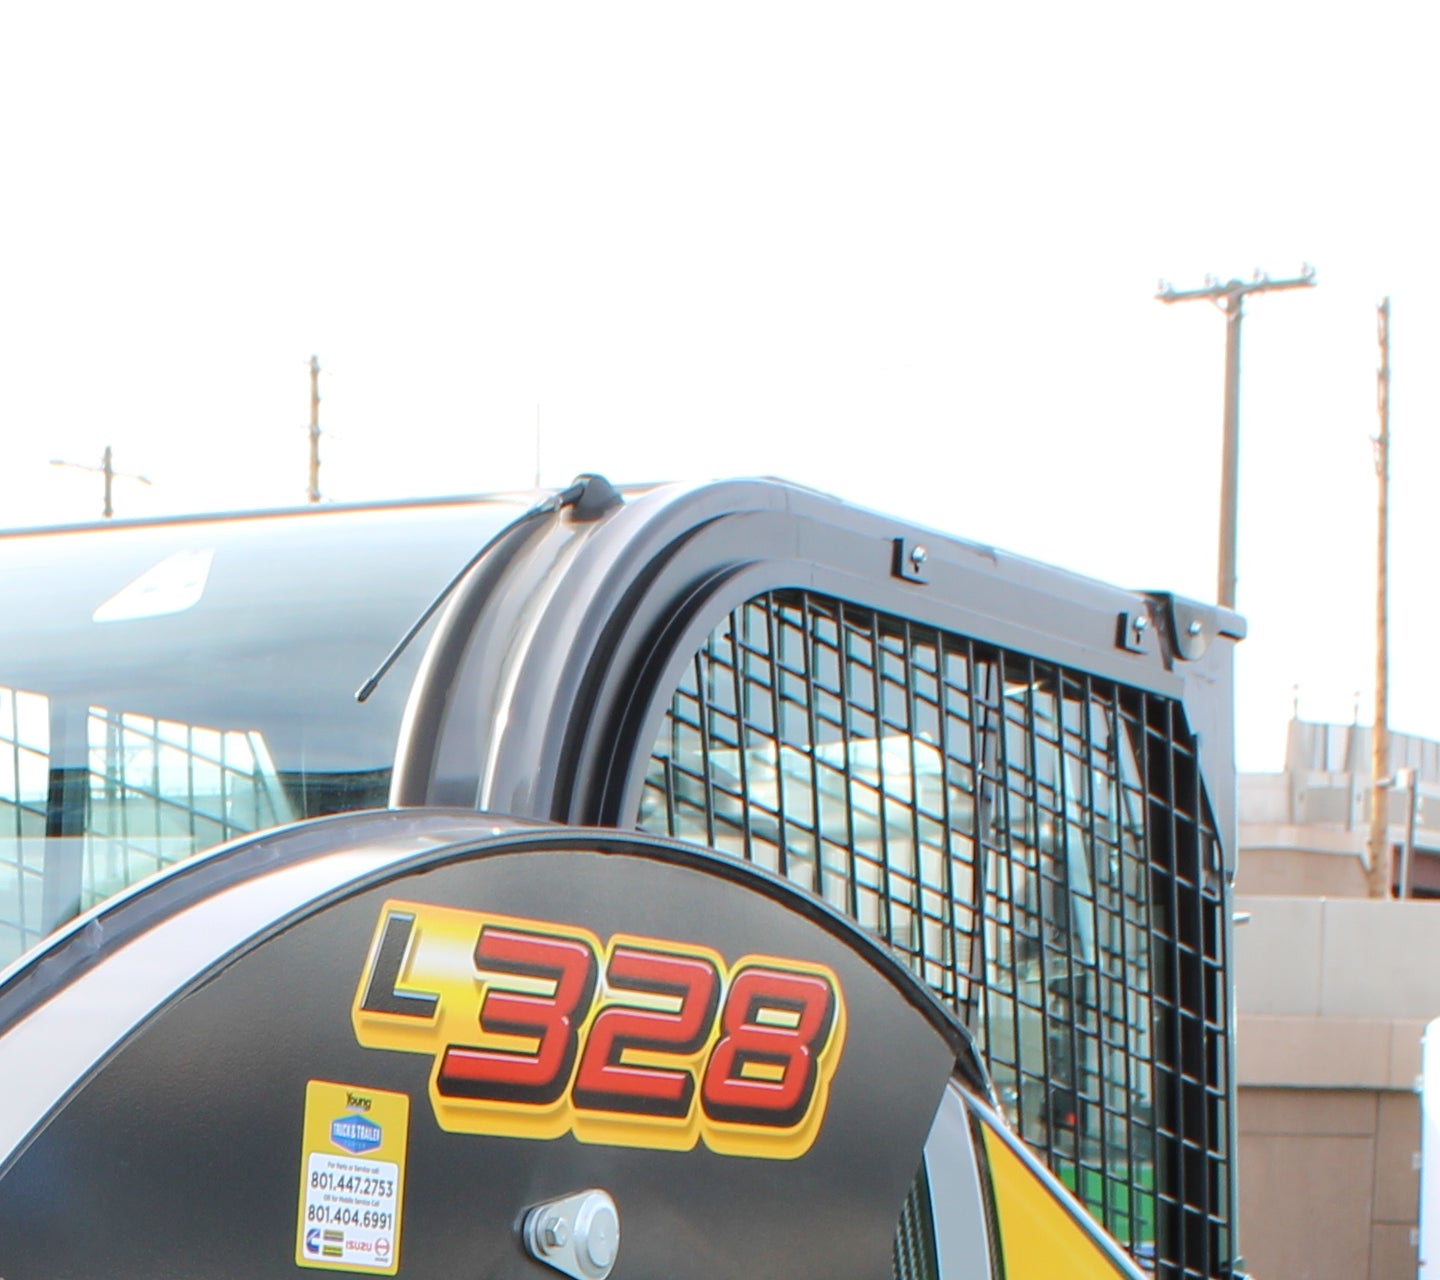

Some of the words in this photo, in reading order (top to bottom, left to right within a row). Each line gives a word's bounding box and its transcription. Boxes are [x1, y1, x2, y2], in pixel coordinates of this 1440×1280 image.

[360, 910, 837, 1128] L328
[311, 1171, 394, 1198] 801.447.2753
[308, 1203, 392, 1231] 801.404.6991
